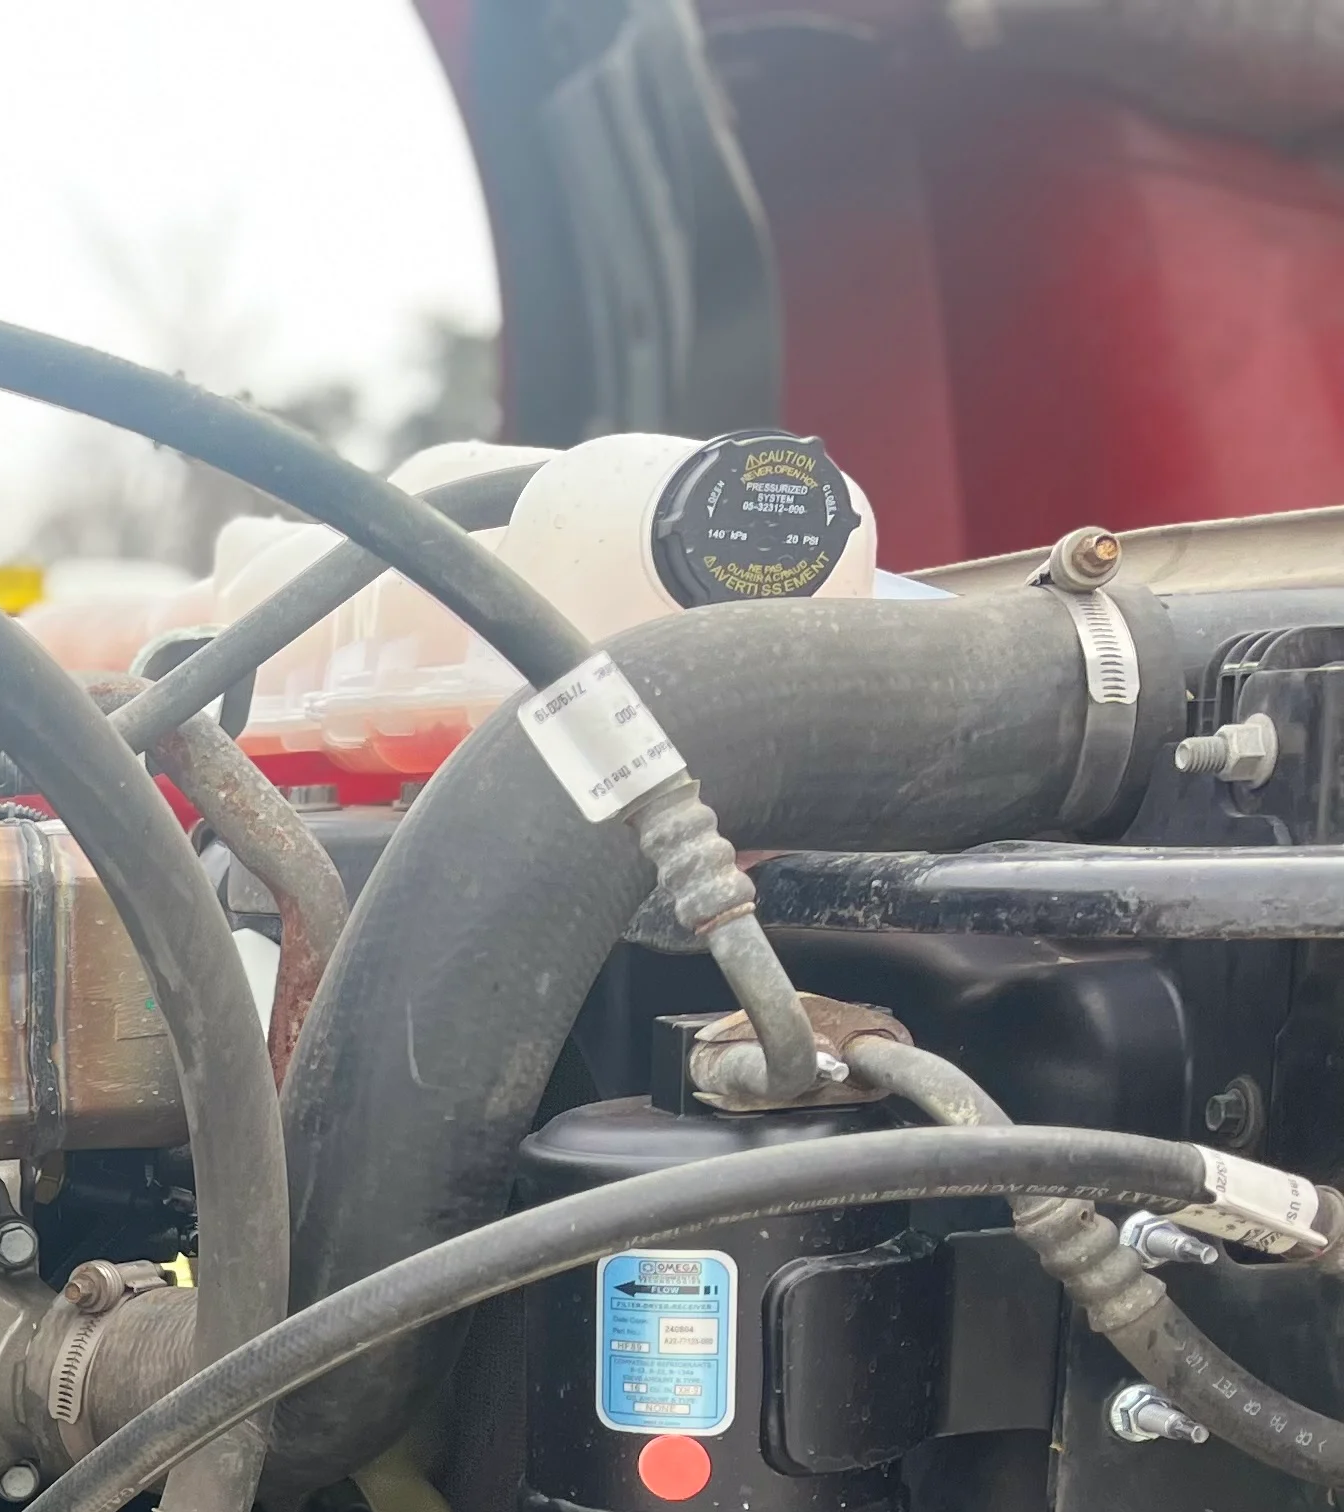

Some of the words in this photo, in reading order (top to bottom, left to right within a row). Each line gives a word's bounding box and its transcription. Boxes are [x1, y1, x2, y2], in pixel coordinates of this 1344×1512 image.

[759, 449, 816, 473] CAUTION
[774, 465, 801, 480] OPEN
[707, 480, 725, 507] OPEN
[746, 482, 808, 496] PRESSURIZED
[757, 493, 794, 504] SYSTEM
[822, 484, 838, 513] CLOSE
[708, 529, 725, 540] 140
[786, 535, 799, 545] 20
[803, 536, 819, 546] PSI
[749, 563, 763, 574] NE
[764, 563, 783, 574] PAS
[589, 777, 615, 800] USA
[656, 1262, 700, 1274] OMEGA
[651, 1286, 680, 1295] FLOW
[645, 1403, 677, 1414] NONE
